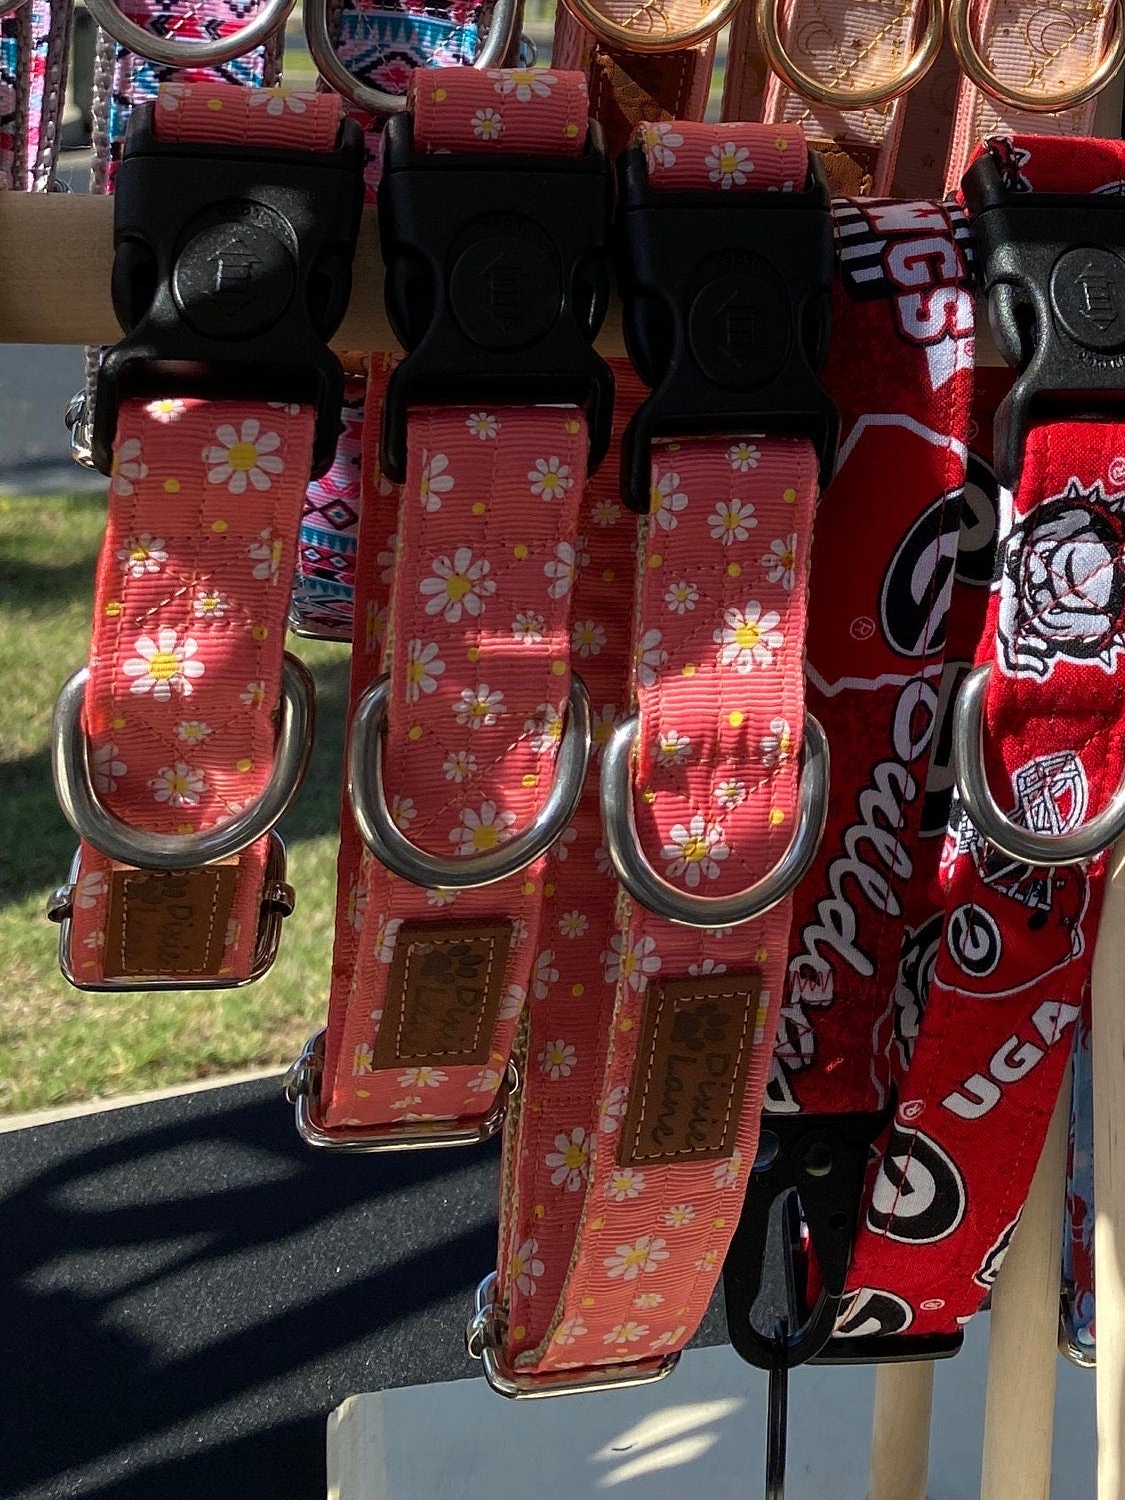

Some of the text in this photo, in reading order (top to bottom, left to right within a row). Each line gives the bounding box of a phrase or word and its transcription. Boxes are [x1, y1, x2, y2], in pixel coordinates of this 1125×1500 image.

[651, 1054, 698, 1146] Lane
[684, 1053, 732, 1148] Dixie
[941, 1001, 1081, 1120] UGA
